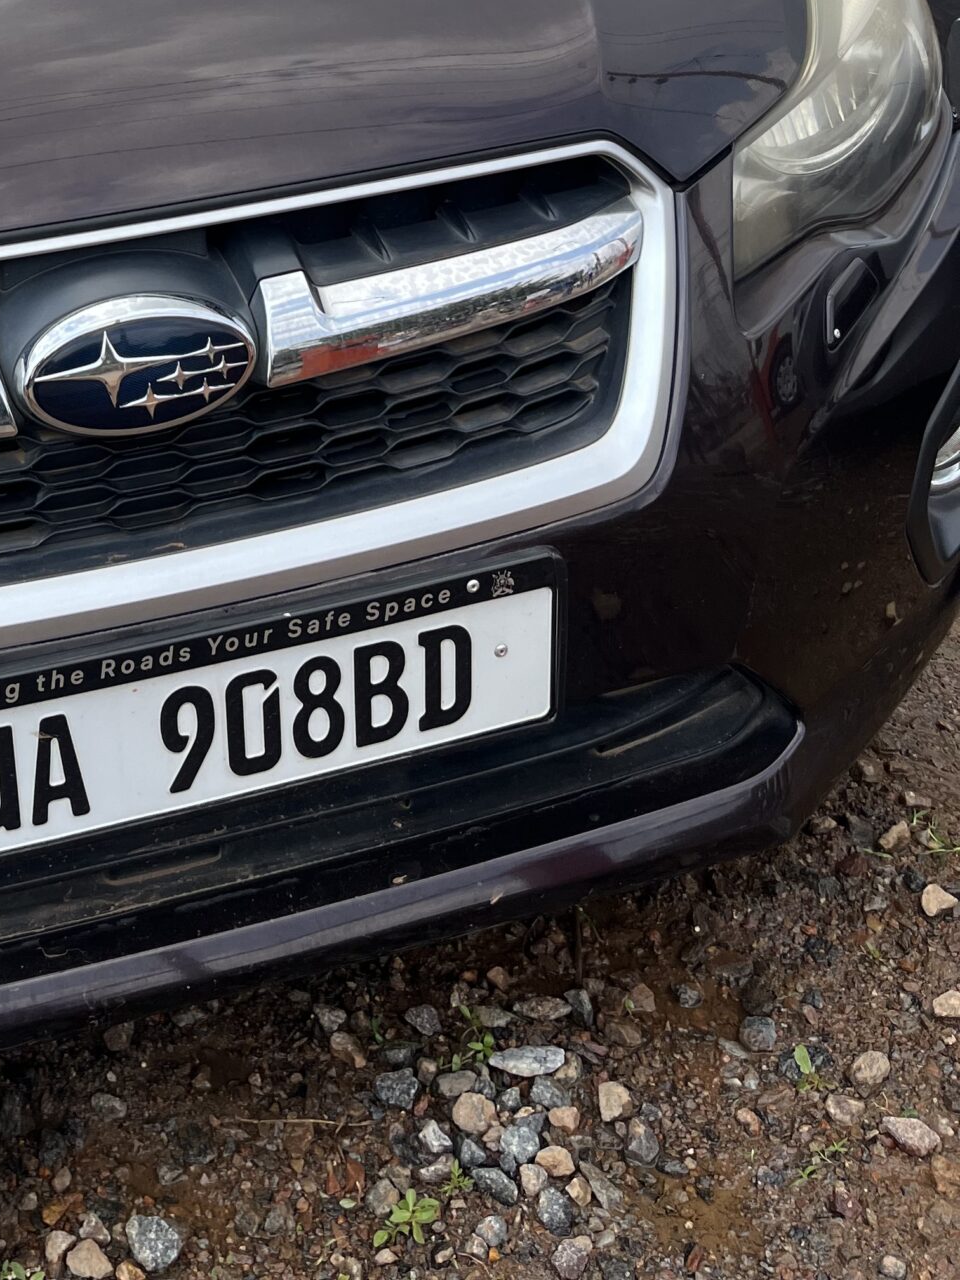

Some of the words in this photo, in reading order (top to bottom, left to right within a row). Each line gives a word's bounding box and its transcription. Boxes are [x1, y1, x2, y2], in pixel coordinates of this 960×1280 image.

[36, 669, 85, 693] the
[100, 644, 192, 680] Roads
[207, 629, 274, 656] Your
[287, 610, 351, 638] Safe
[365, 588, 452, 621] Space
[159, 623, 473, 795] 908BD
